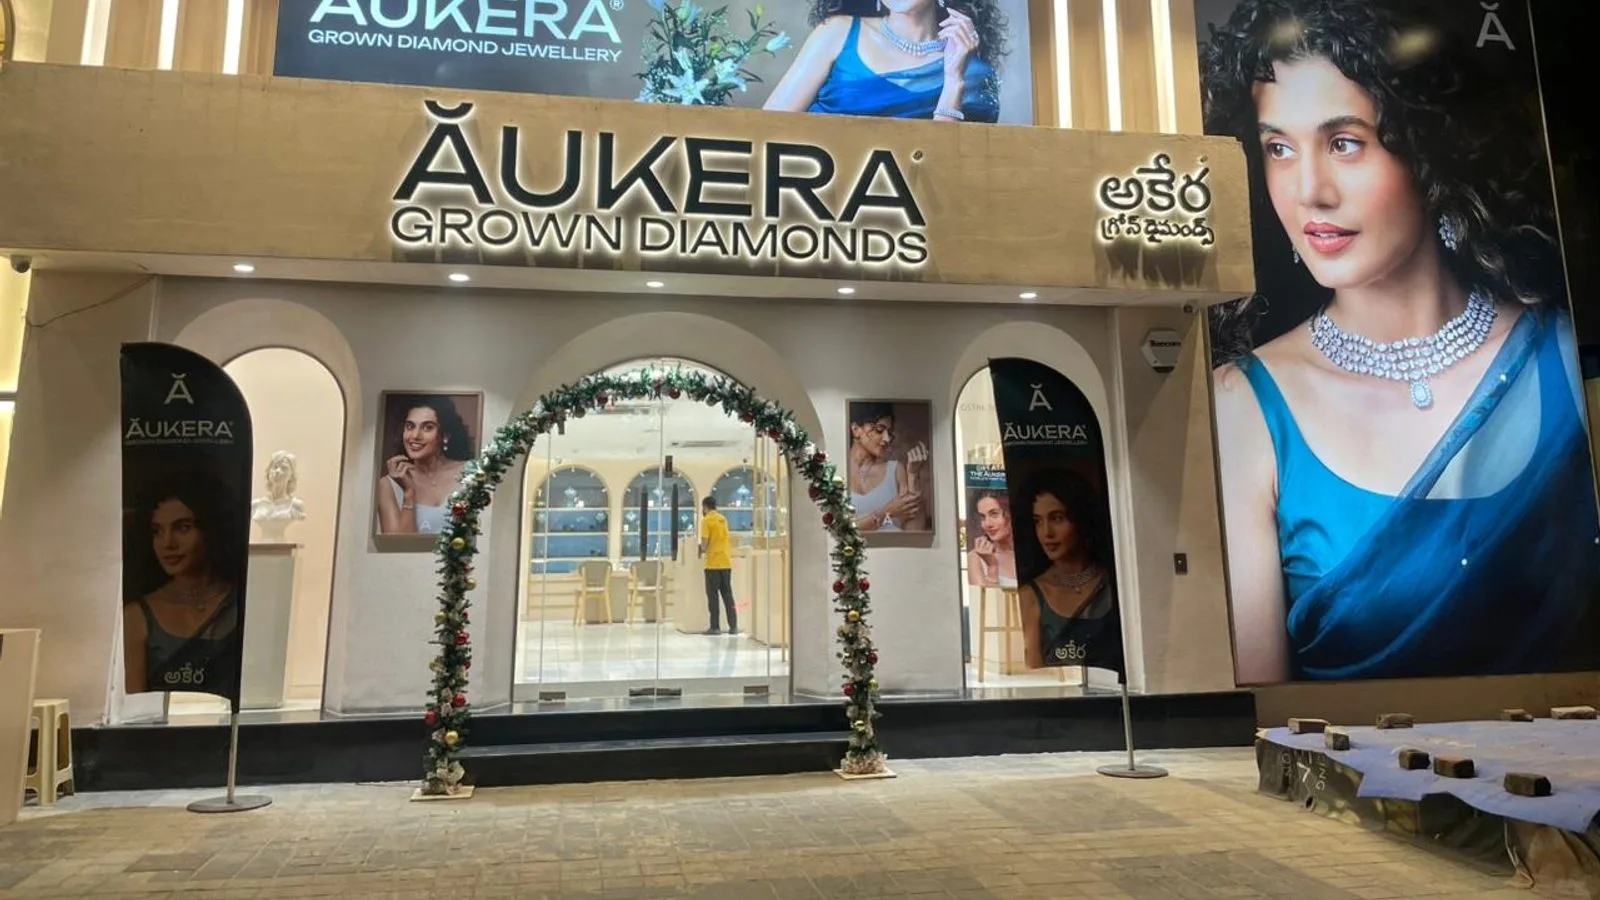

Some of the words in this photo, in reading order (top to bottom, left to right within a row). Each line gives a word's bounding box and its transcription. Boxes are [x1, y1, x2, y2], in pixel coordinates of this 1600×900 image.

[308, 29, 393, 49] GROWN
[398, 34, 498, 55] DIAMOND
[502, 43, 622, 63] JEWELLERY
[391, 206, 622, 251] GROWN
[640, 217, 928, 264] DIAMONDS
